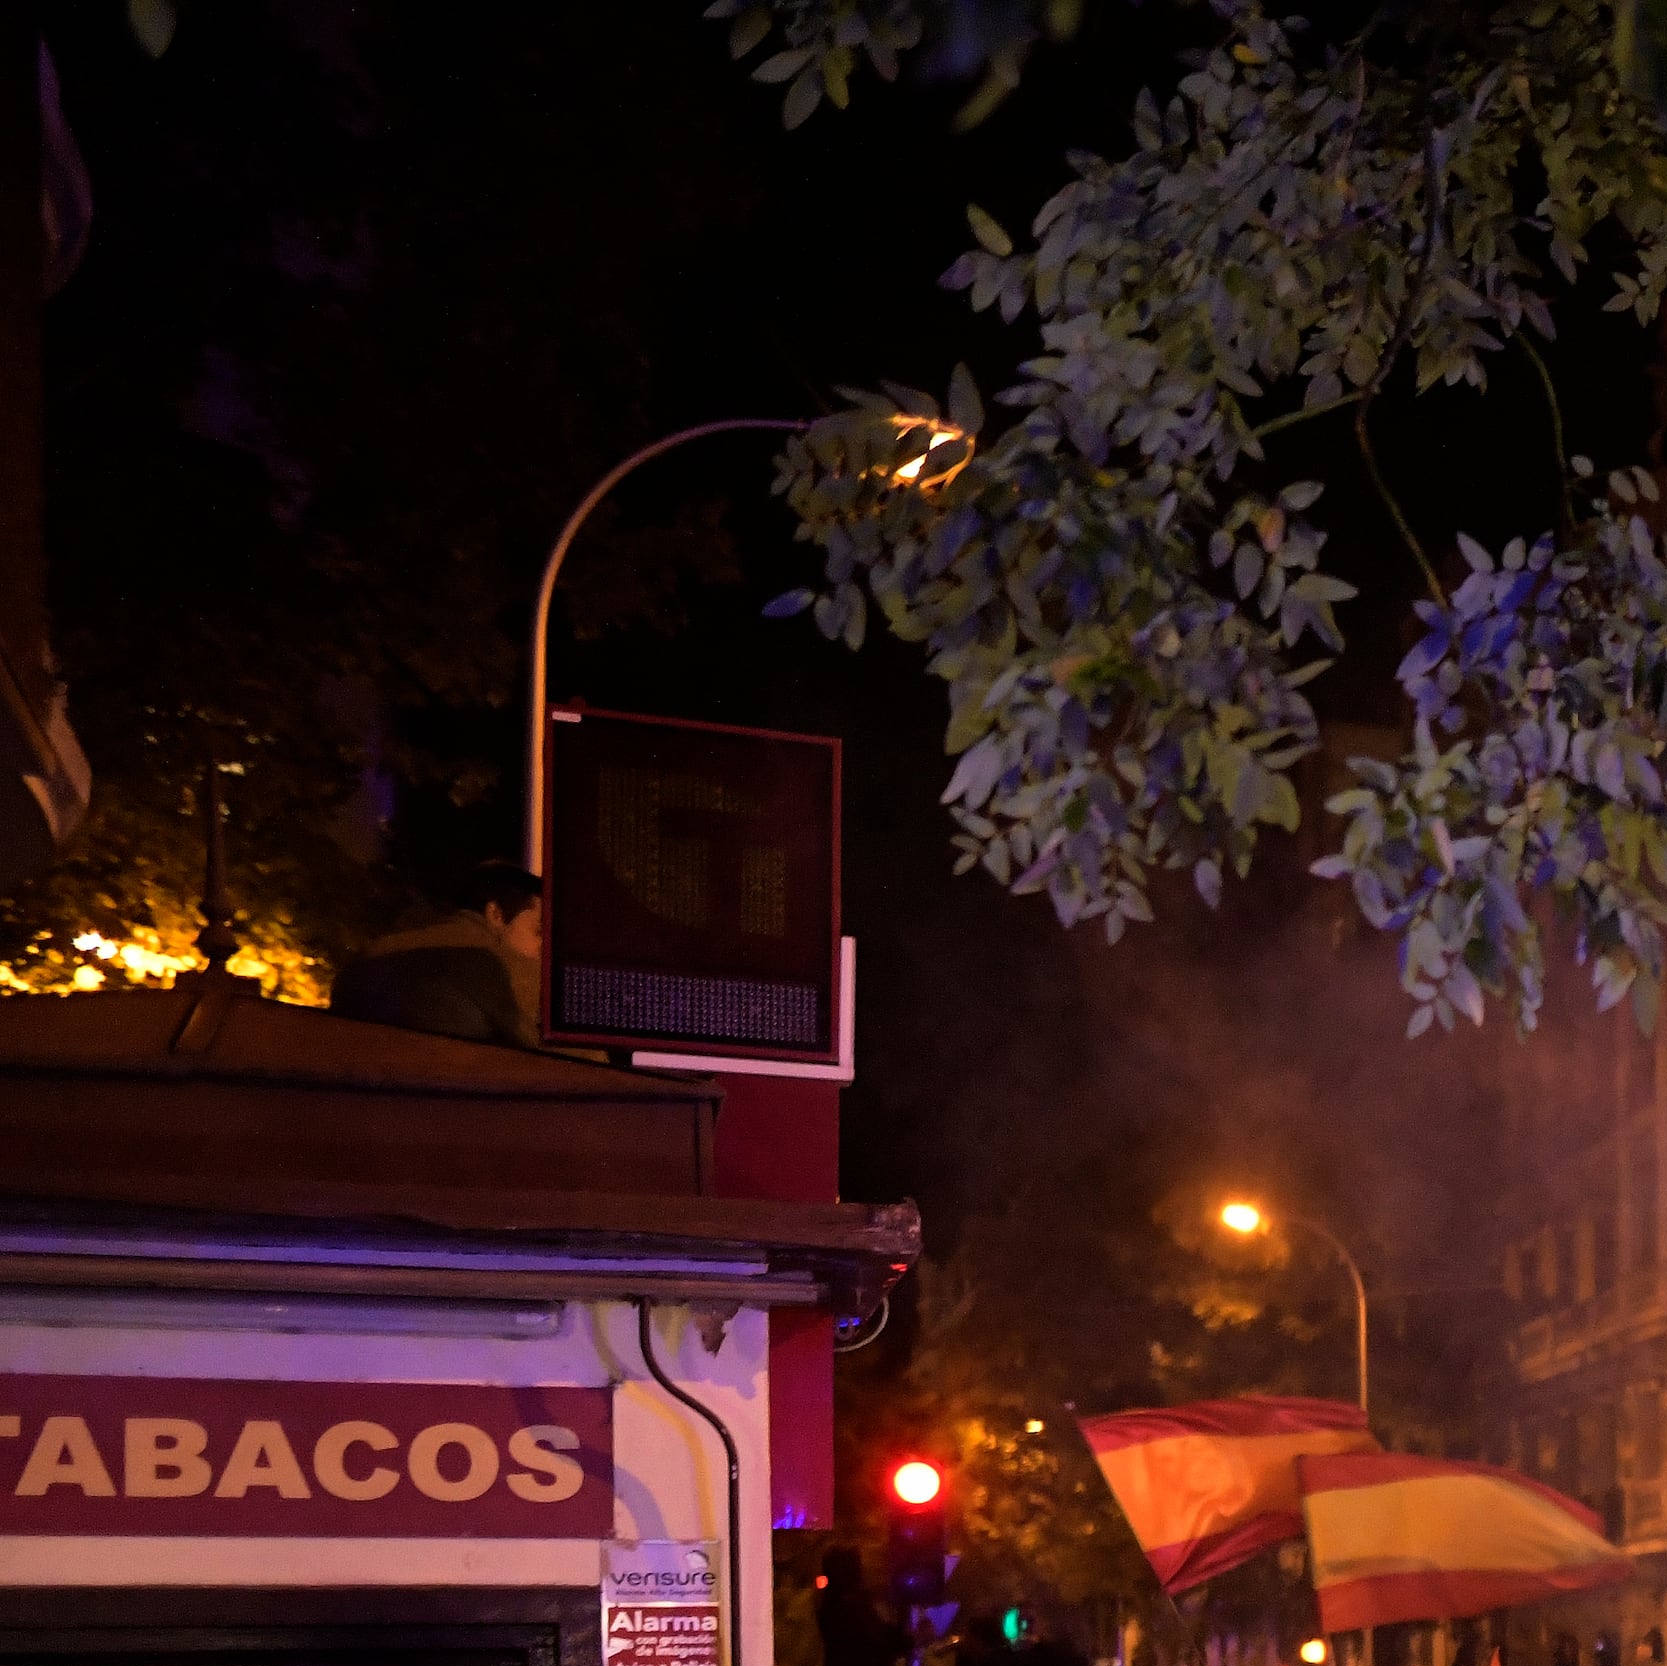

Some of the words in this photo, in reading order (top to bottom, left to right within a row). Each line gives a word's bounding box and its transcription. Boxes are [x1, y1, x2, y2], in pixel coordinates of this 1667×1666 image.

[0, 1415, 585, 1502] ABACOS
[609, 1571, 717, 1586] verisure
[609, 1610, 719, 1633] Alarma
